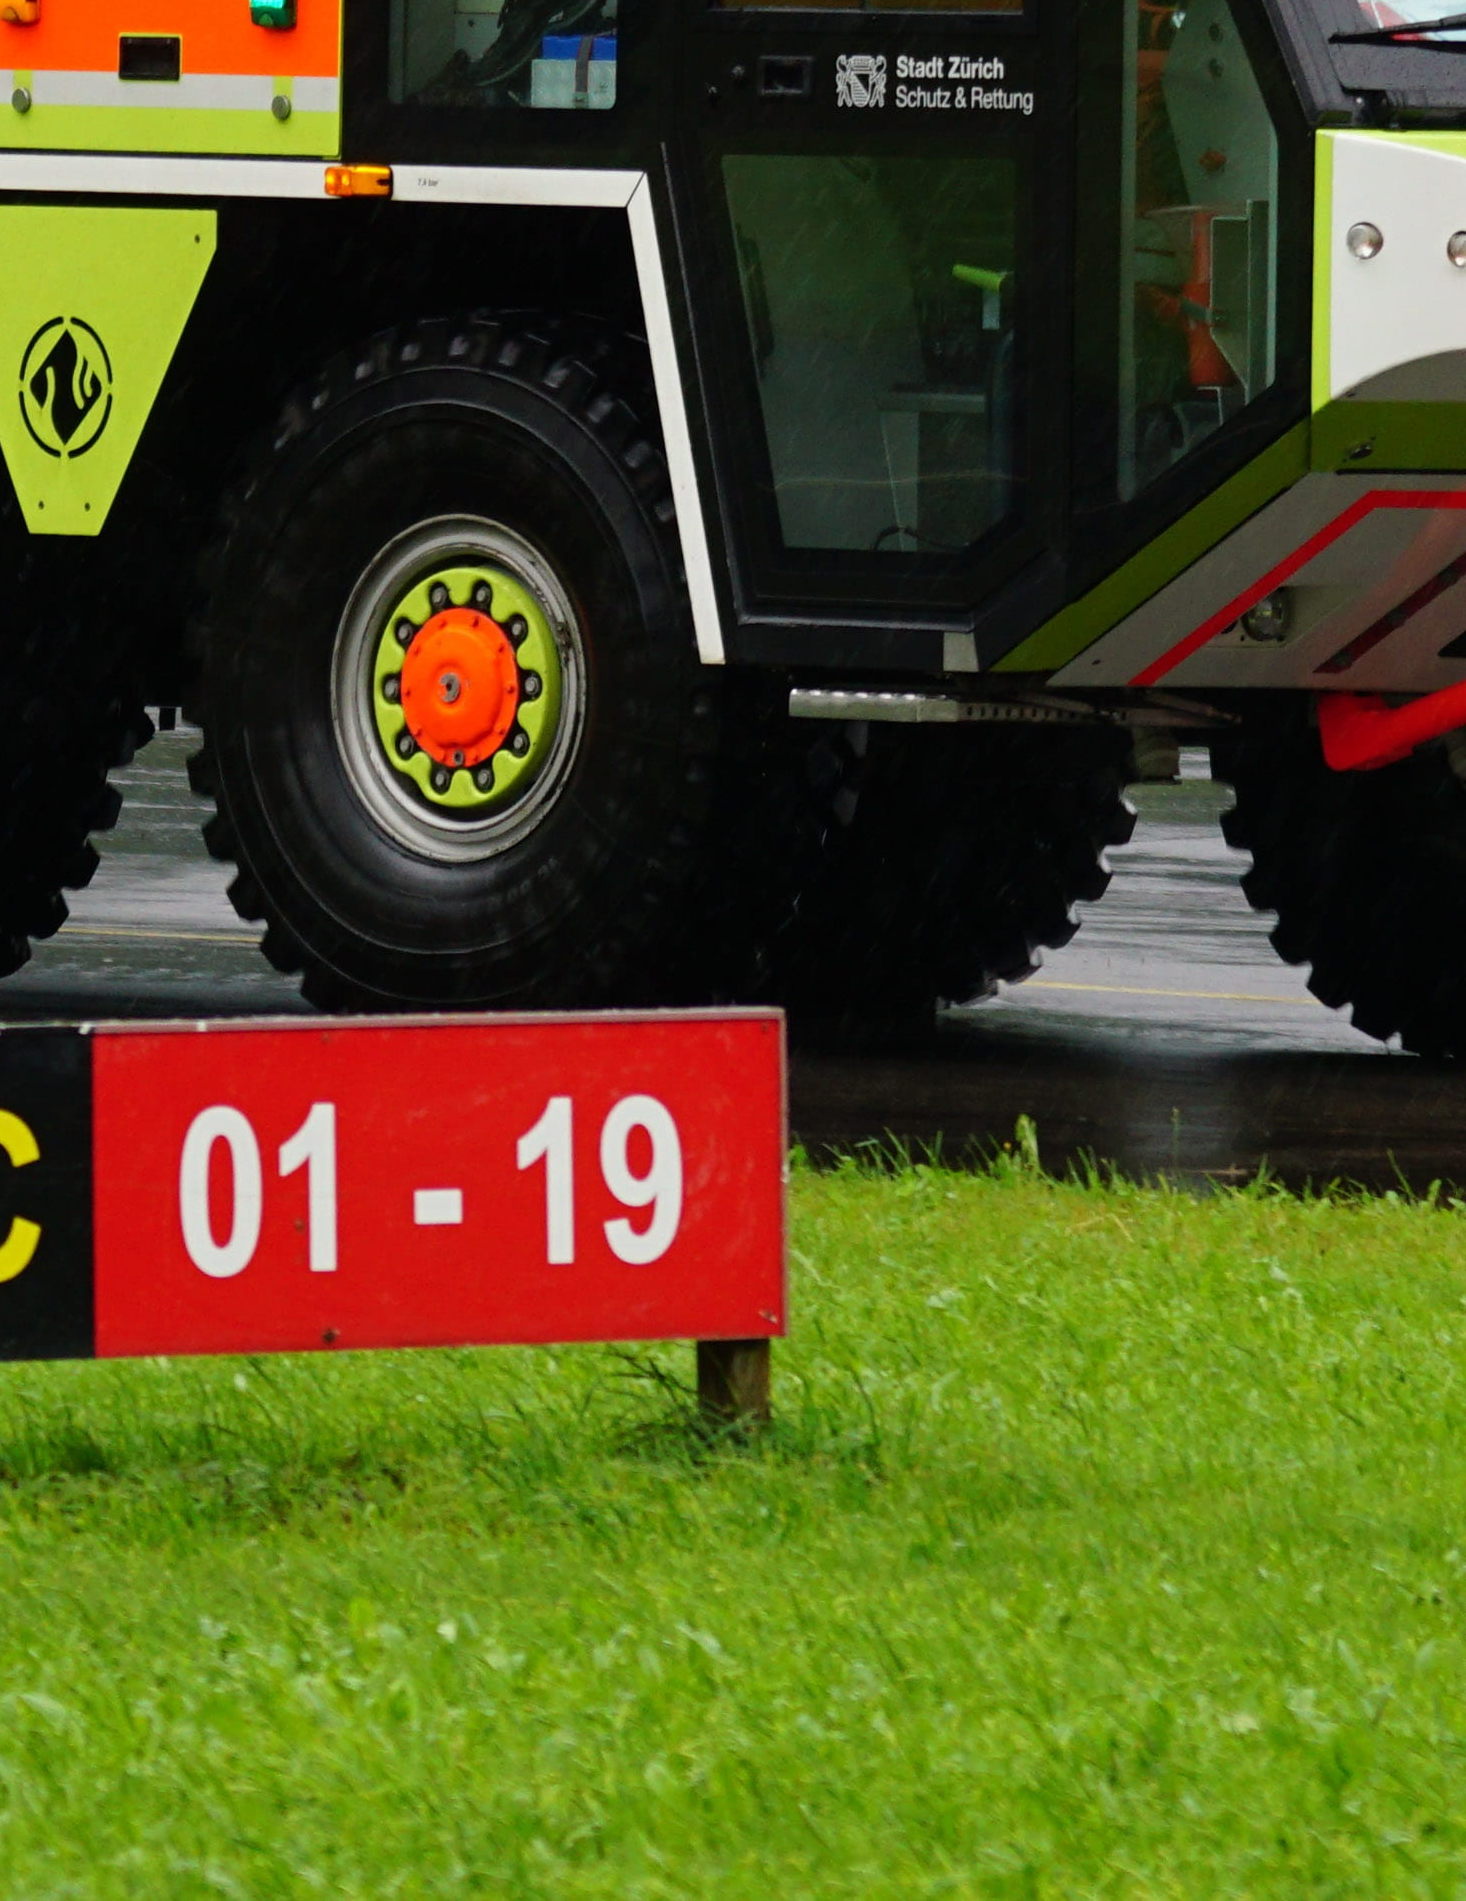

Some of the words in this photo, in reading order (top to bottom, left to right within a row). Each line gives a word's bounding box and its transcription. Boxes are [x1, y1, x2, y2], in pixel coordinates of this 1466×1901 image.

[895, 54, 945, 79] Stadt
[948, 55, 1005, 80] Zürich
[895, 85, 952, 109] Schutz
[955, 86, 968, 109] &
[971, 86, 1034, 116] Rettung
[179, 1101, 338, 1279] 01
[413, 1189, 463, 1225] -
[516, 1094, 684, 1266] 19
